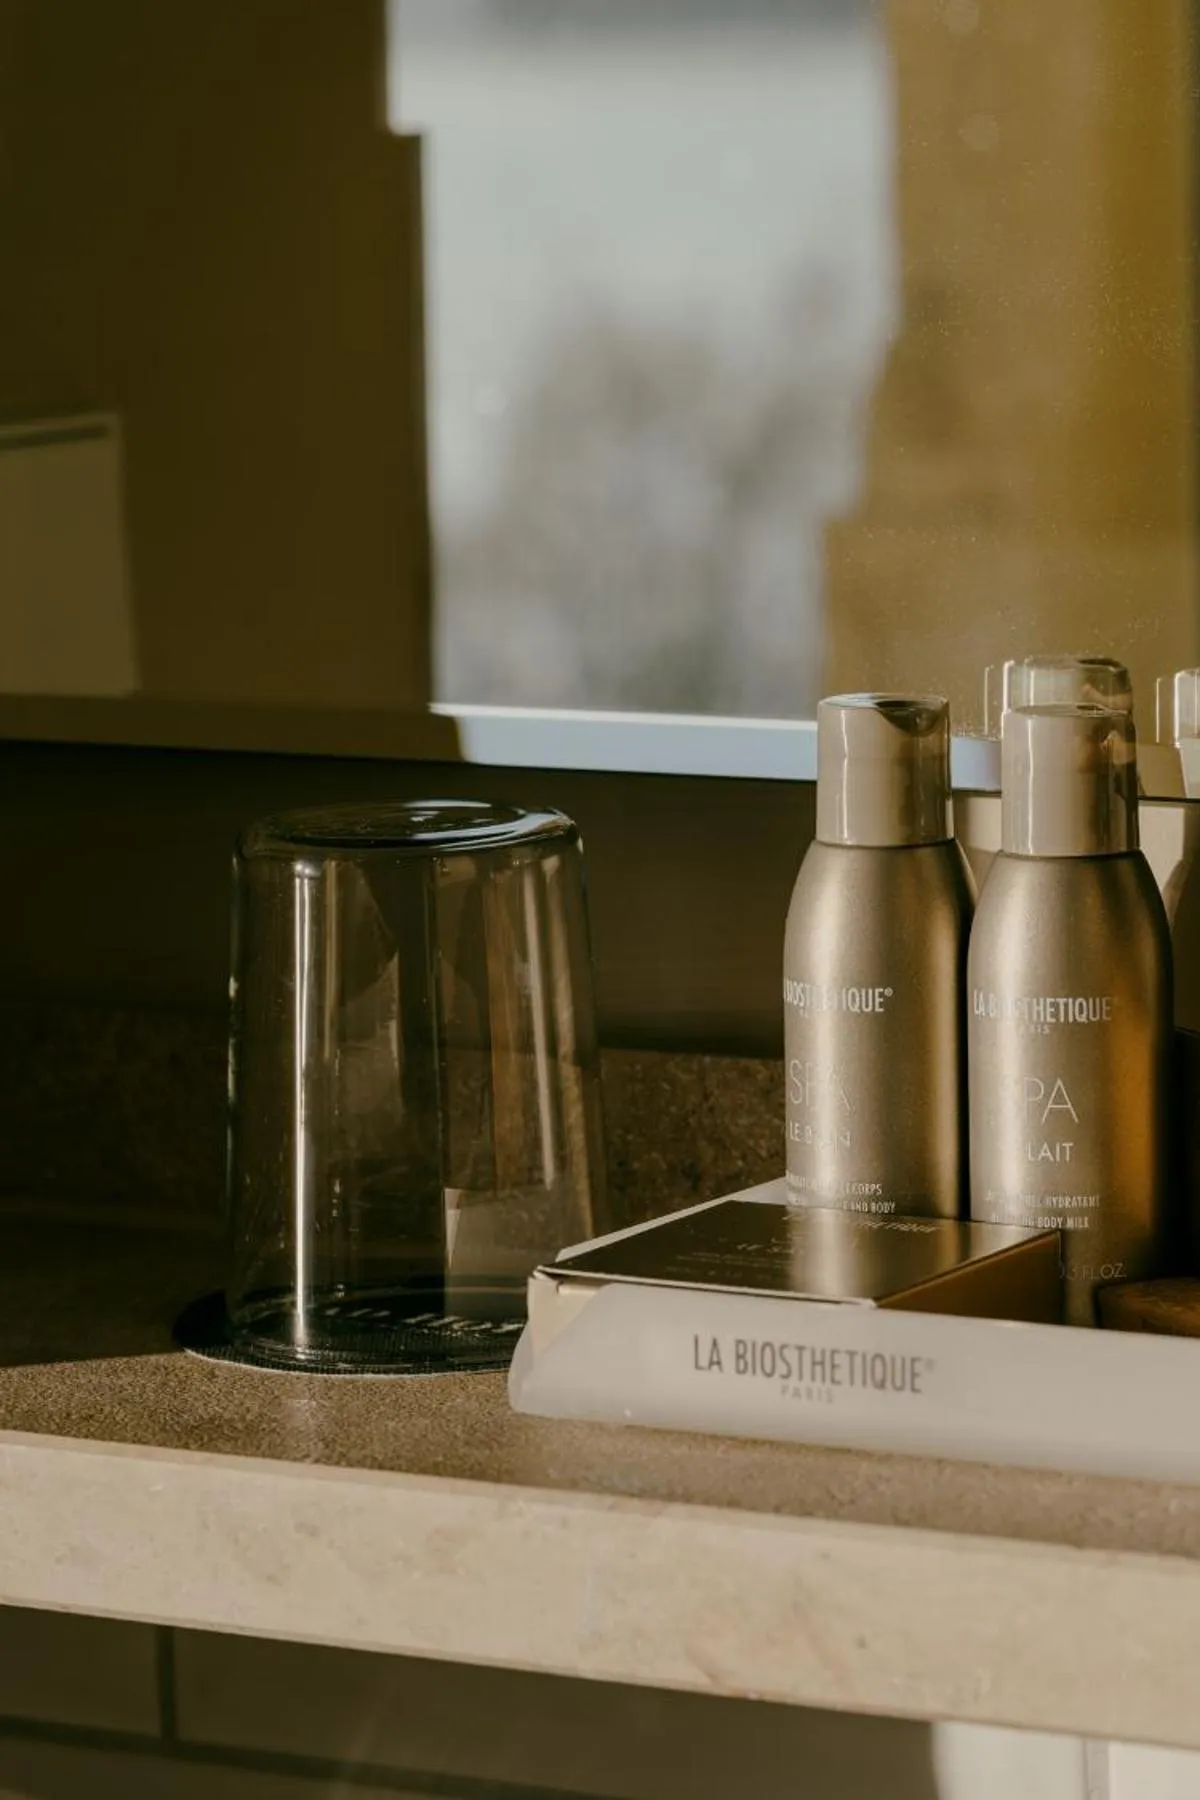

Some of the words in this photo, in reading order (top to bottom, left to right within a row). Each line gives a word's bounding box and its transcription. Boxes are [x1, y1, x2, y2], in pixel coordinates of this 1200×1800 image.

[973, 988, 985, 1017] LA
[789, 1119, 801, 1142] LE
[1027, 1141, 1075, 1164] LAIT
[870, 1201, 896, 1214] BODY
[1037, 1215, 1063, 1229] BODY
[693, 1333, 724, 1373] LA
[781, 1384, 834, 1404] PARIS
